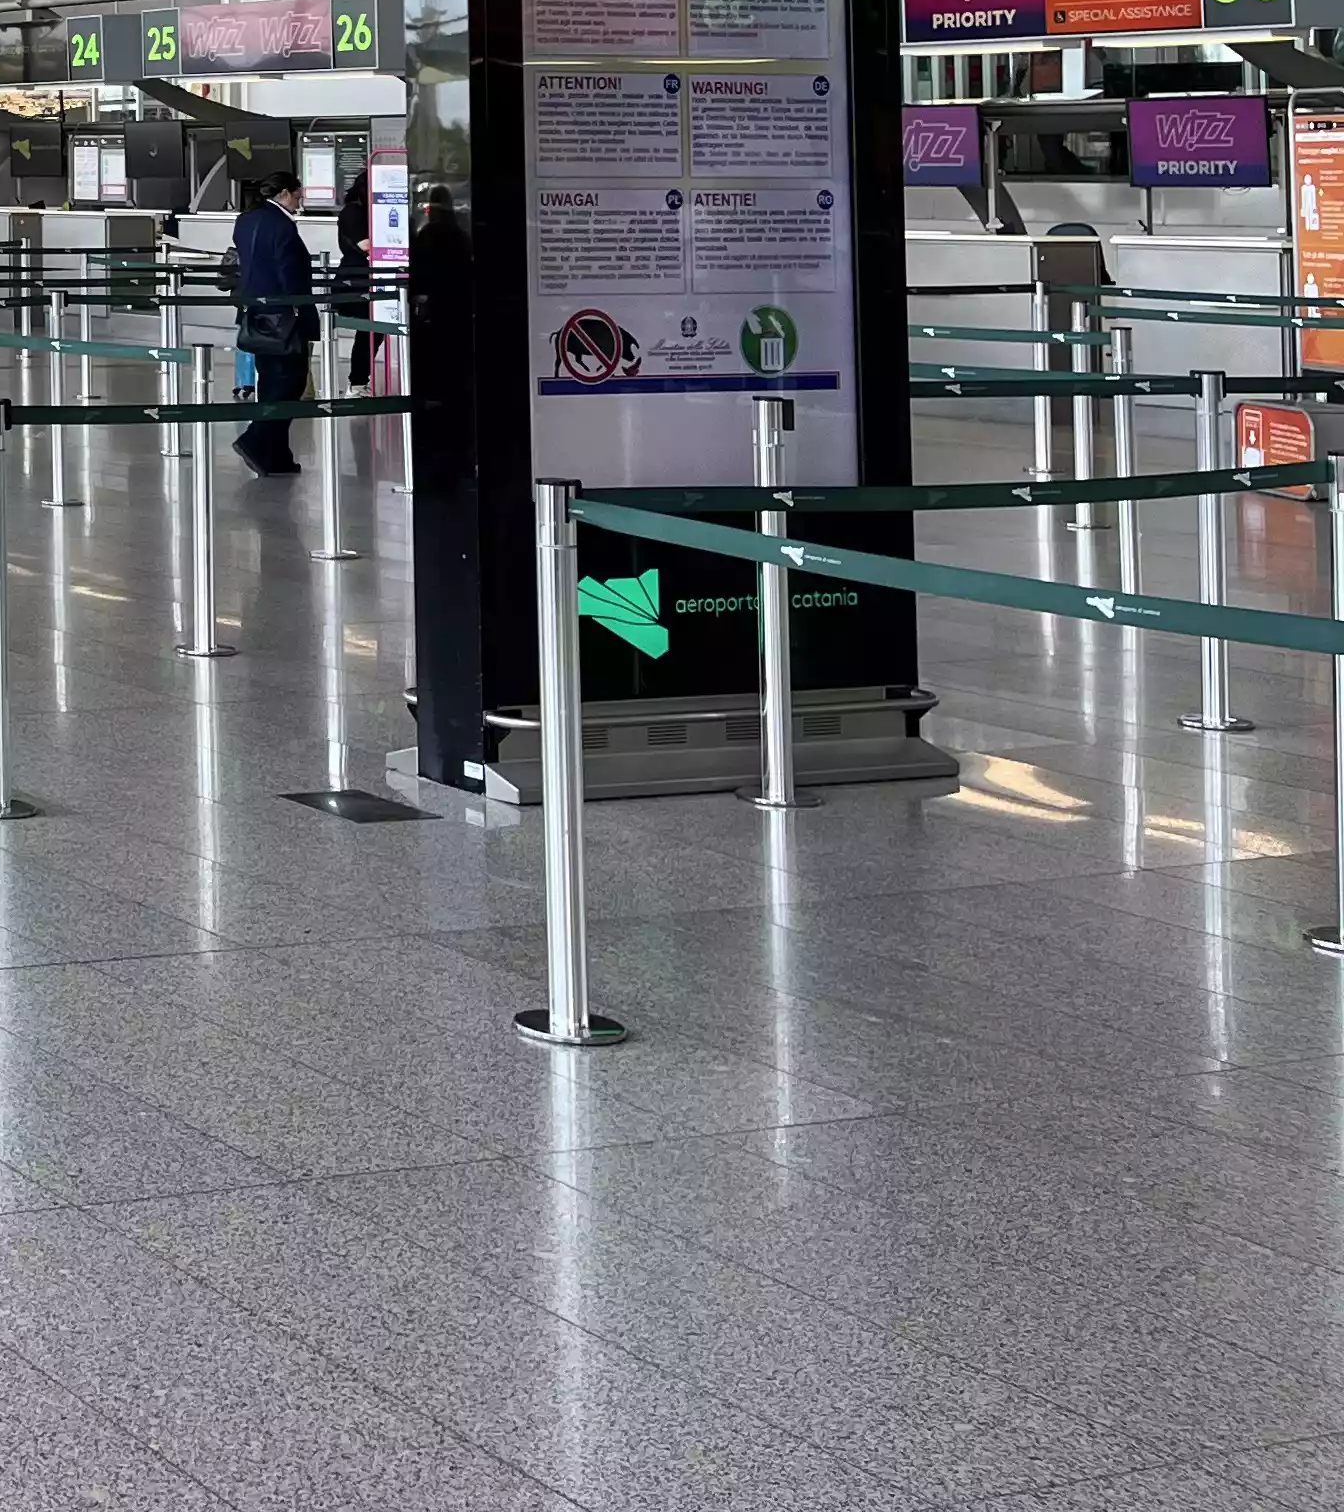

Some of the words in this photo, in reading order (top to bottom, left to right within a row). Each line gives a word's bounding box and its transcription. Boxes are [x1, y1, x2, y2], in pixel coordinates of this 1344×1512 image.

[932, 8, 1017, 30] PRIORITY
[1068, 7, 1117, 23] SPECIAL
[1117, 3, 1193, 21] ASSISTANCE
[336, 12, 373, 53] 26
[71, 32, 100, 67] 24
[147, 25, 177, 61] 25
[538, 75, 623, 90] ATTENTION!
[665, 79, 679, 89] FR
[691, 81, 769, 96] WARNUNG!
[814, 82, 828, 92] DE
[1157, 159, 1239, 176] PRIORITY
[540, 192, 599, 207] UWAGA!
[667, 194, 682, 205] PL
[818, 194, 833, 205] RO
[791, 586, 859, 608] catania
